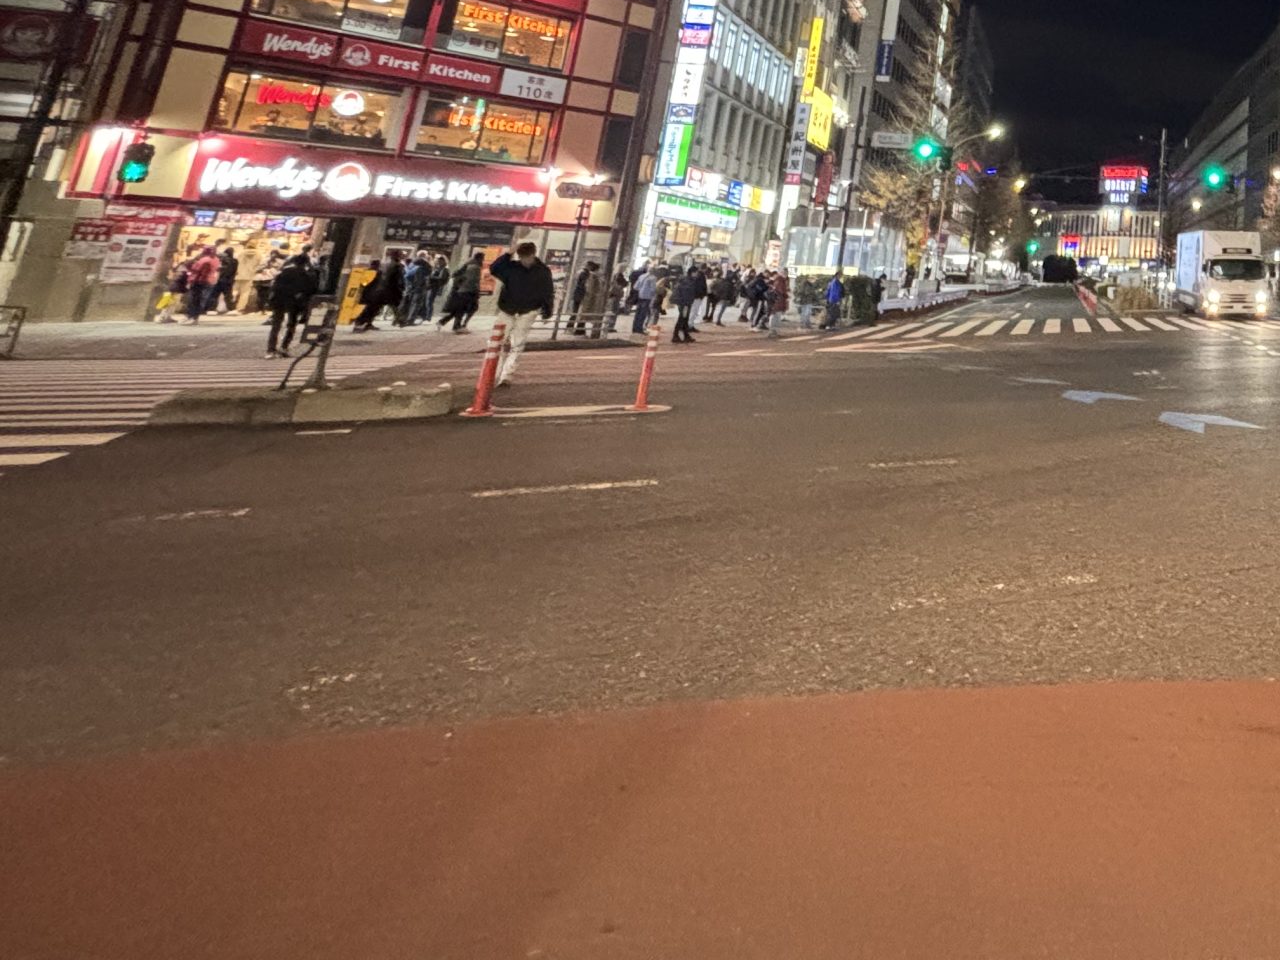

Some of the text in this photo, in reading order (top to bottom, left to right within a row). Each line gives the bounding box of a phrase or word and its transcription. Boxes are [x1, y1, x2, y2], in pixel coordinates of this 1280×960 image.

[463, 4, 564, 38] First Kitchen
[262, 32, 491, 85] Wendy's First Kitchen
[256, 84, 331, 111] Wendy's
[200, 156, 545, 207] Wendy's First Kitchen
